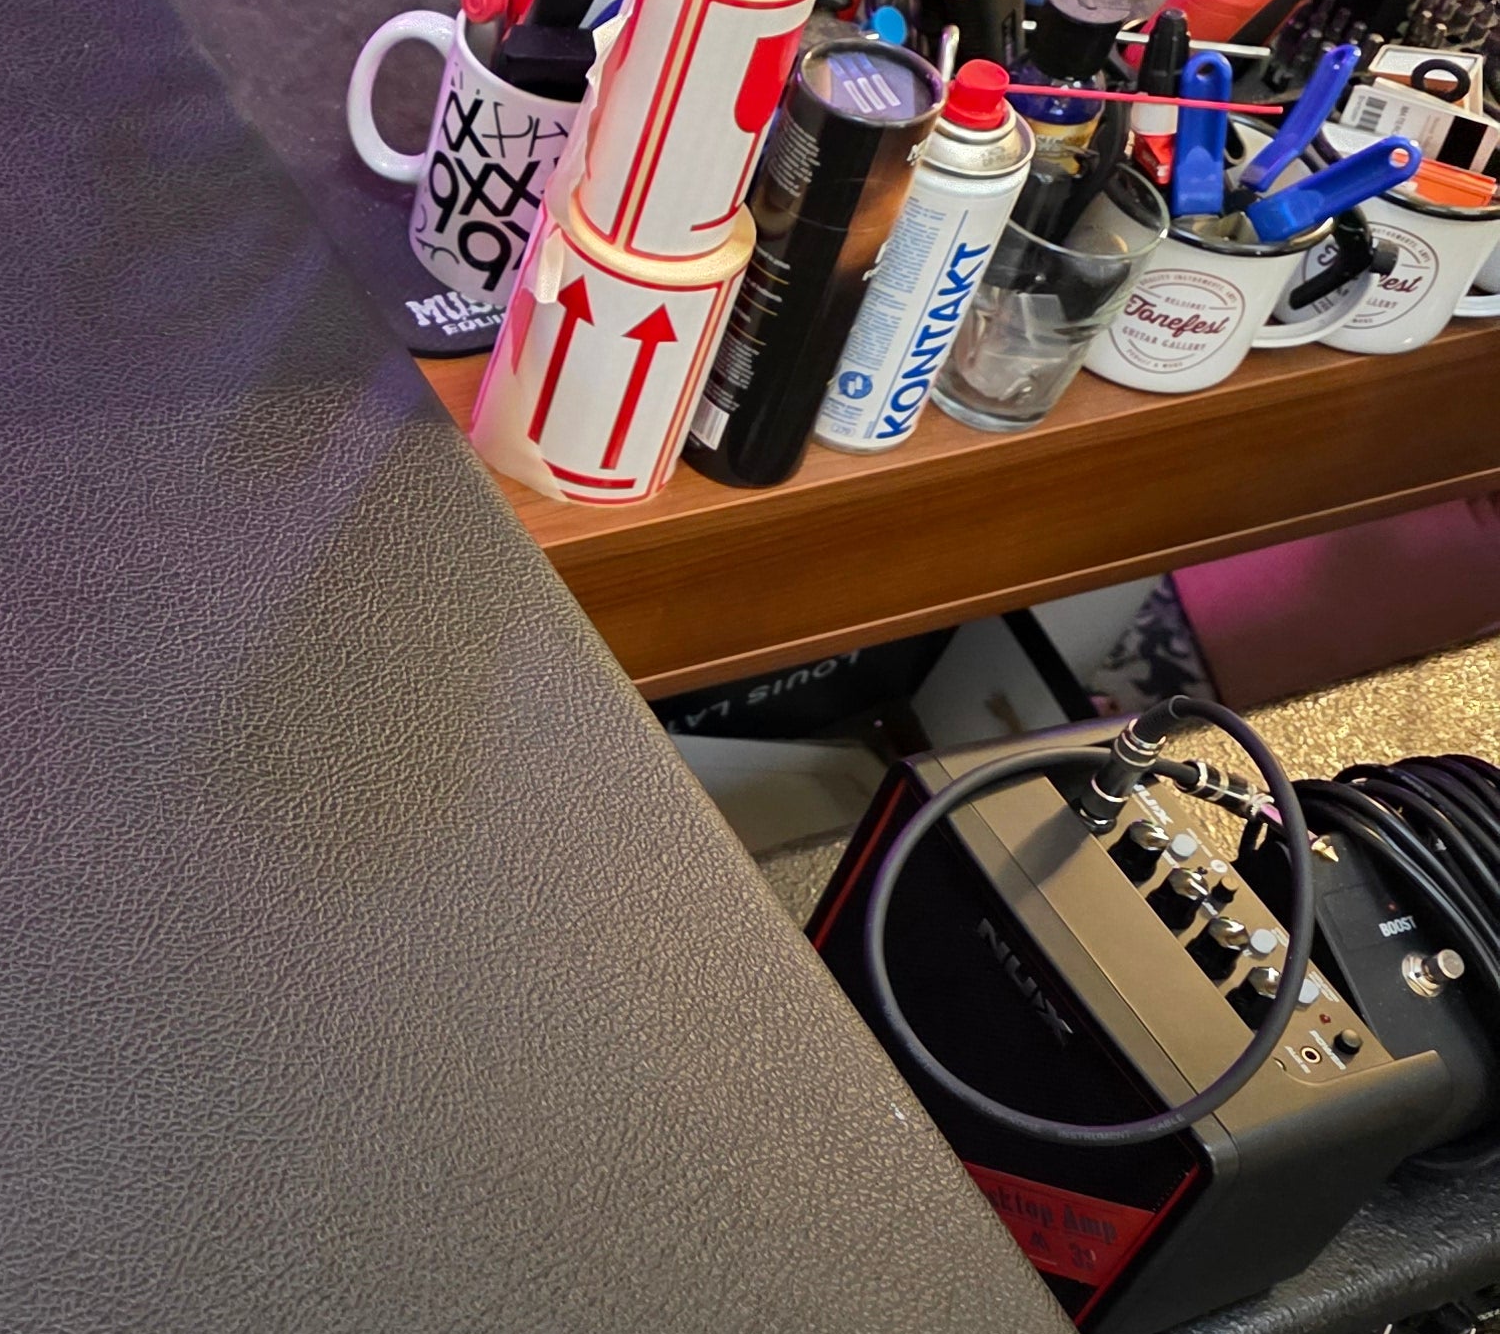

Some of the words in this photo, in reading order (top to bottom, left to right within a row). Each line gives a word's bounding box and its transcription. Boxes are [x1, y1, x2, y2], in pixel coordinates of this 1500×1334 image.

[442, 312, 506, 336] EQUI
[1123, 293, 1230, 338] Tonefest
[875, 241, 991, 439] KONTAKT
[1122, 325, 1159, 346] GUITAR
[1161, 338, 1207, 352] GALLERY
[1378, 916, 1417, 938] BOOST
[978, 918, 1073, 1045] NUX
